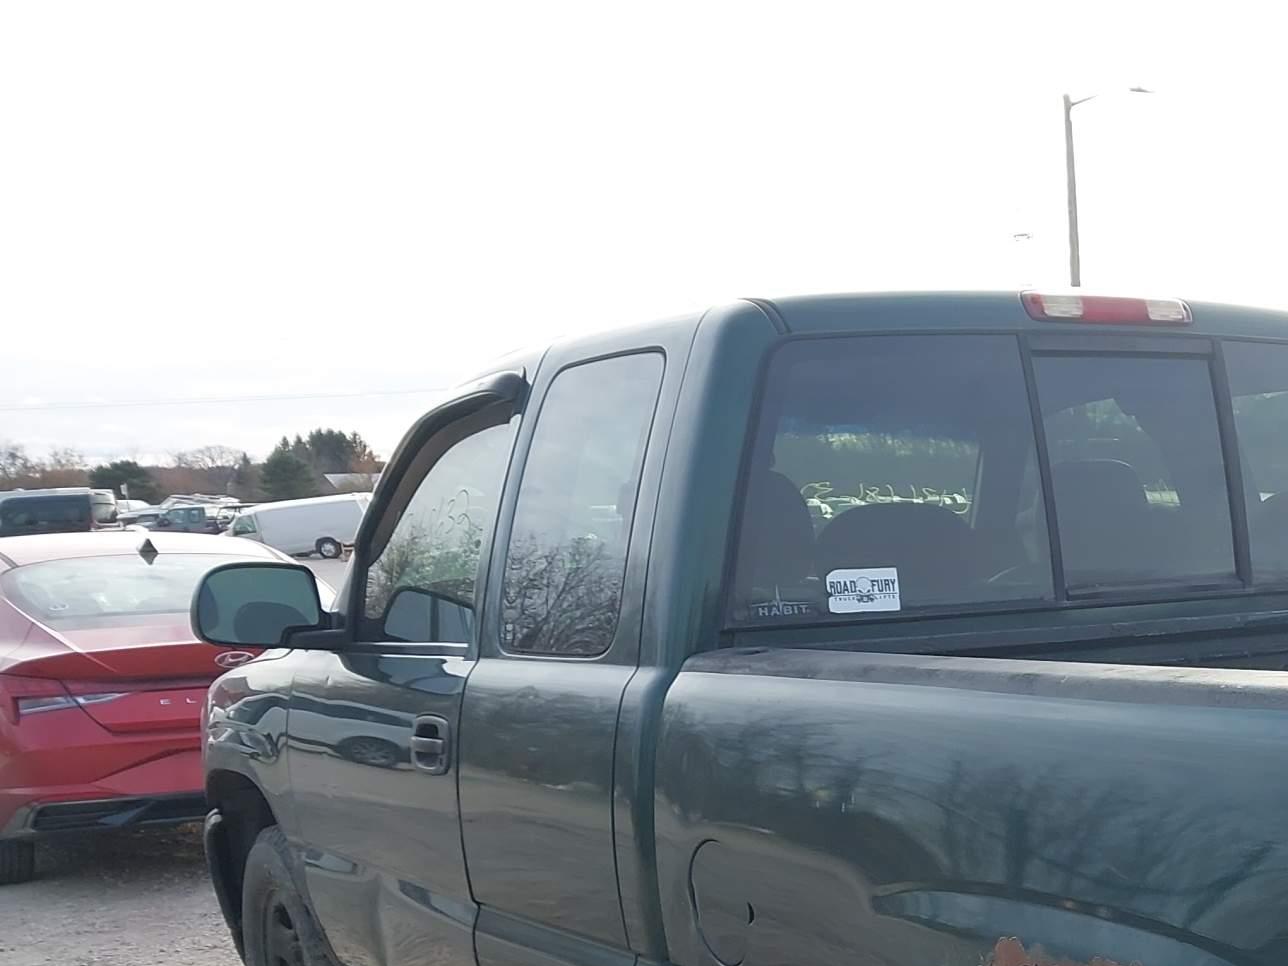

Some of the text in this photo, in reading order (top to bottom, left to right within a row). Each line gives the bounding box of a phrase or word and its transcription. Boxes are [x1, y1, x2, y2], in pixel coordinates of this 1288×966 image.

[829, 578, 897, 595] ROAD FURY
[758, 604, 809, 616] HABIT
